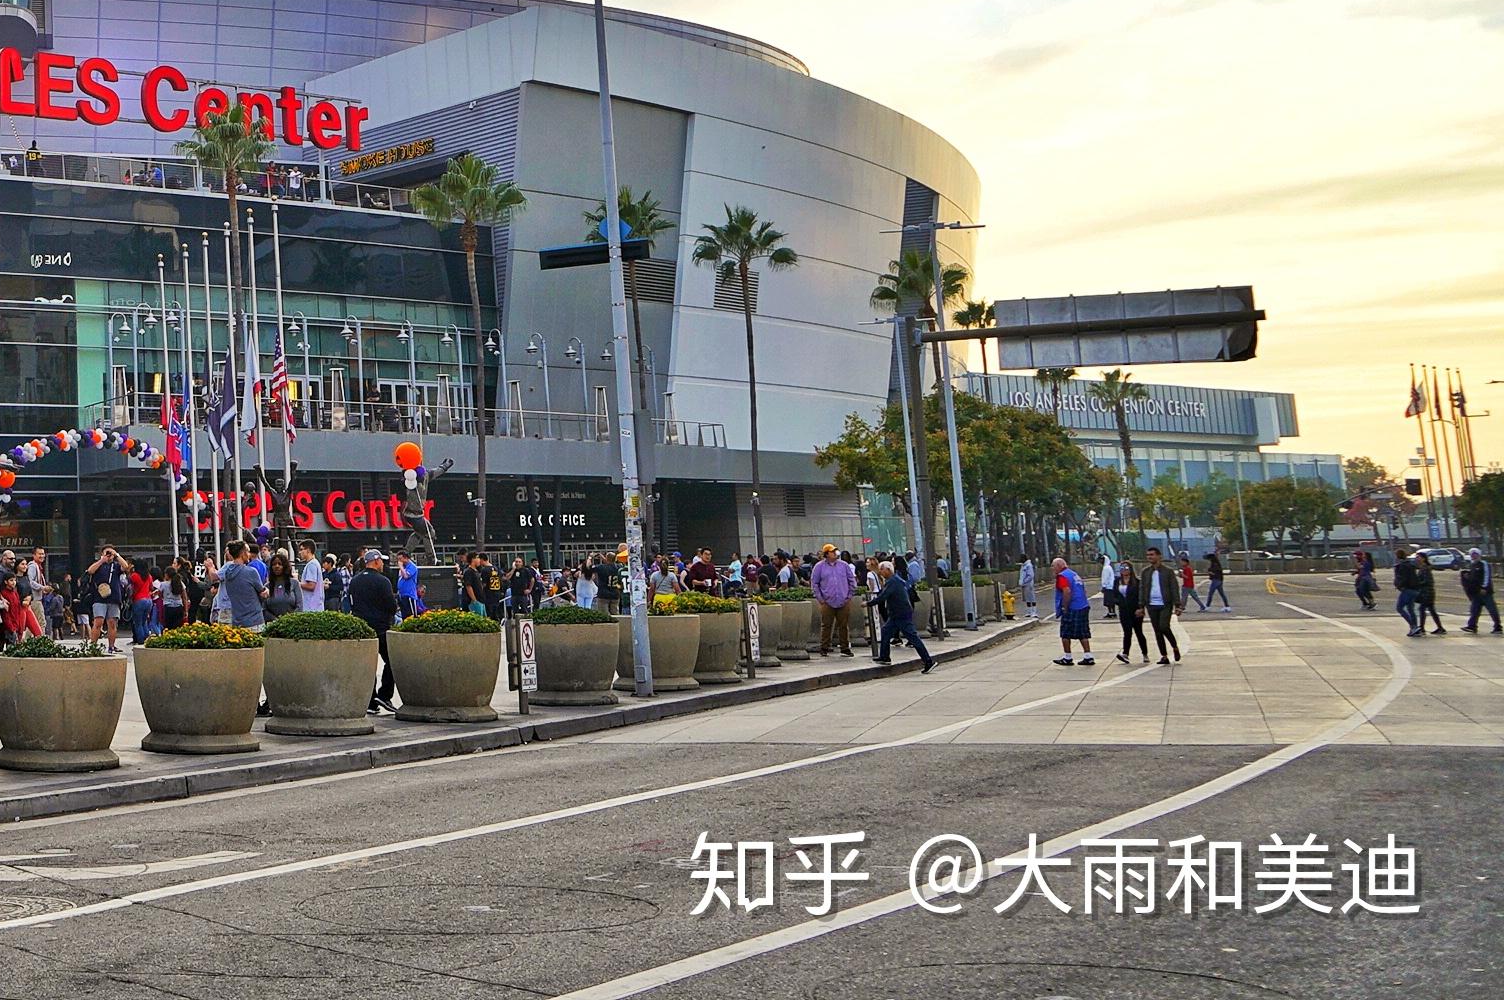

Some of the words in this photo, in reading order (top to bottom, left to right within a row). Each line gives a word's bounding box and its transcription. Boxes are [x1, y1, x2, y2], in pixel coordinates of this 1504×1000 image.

[141, 65, 369, 151] Center
[1009, 391, 1031, 407] LOS
[1091, 397, 1164, 416] CONENTION
[1168, 400, 1207, 418] CENTER
[323, 490, 435, 530] Centr
